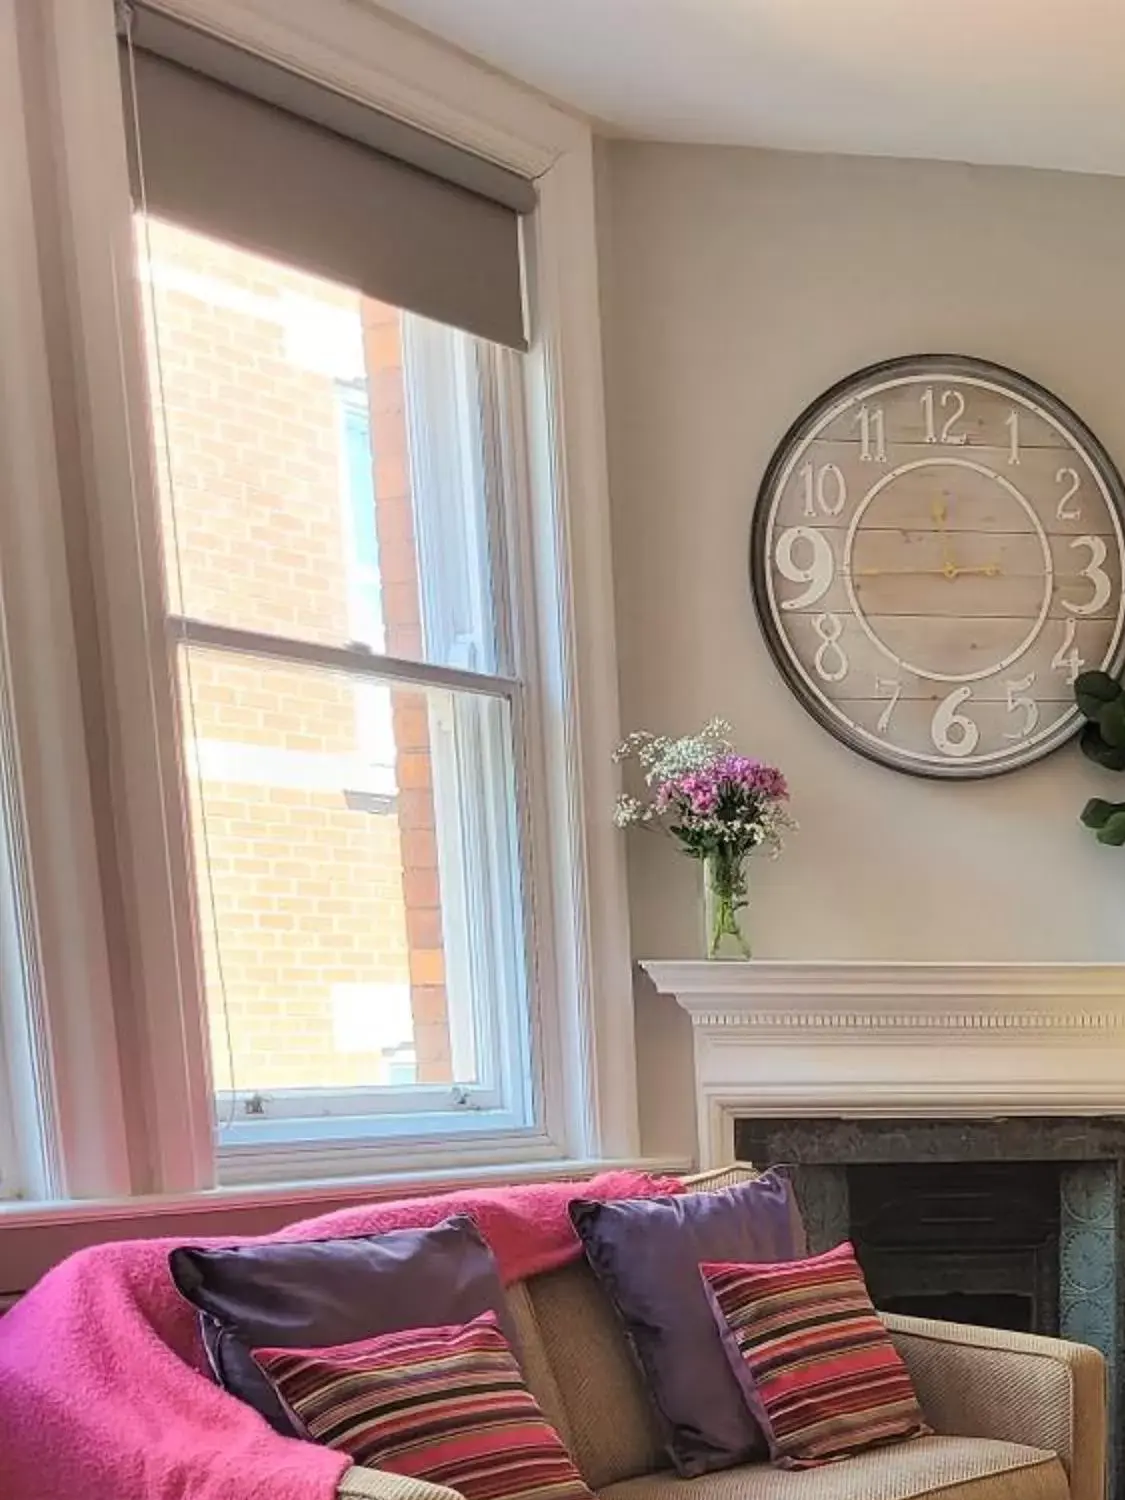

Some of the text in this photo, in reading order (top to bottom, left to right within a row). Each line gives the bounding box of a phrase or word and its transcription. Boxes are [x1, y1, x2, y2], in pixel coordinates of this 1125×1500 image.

[856, 404, 887, 463] 11
[920, 386, 969, 445] 12
[1005, 409, 1021, 465] 1
[800, 461, 847, 517] 10
[1055, 467, 1081, 520] 2
[775, 525, 835, 610] 9
[1061, 535, 1112, 614] 3
[811, 613, 848, 682] 8
[1051, 617, 1085, 685] 4
[875, 677, 902, 731] 7
[931, 686, 981, 756] 6
[1004, 672, 1039, 739] 5
